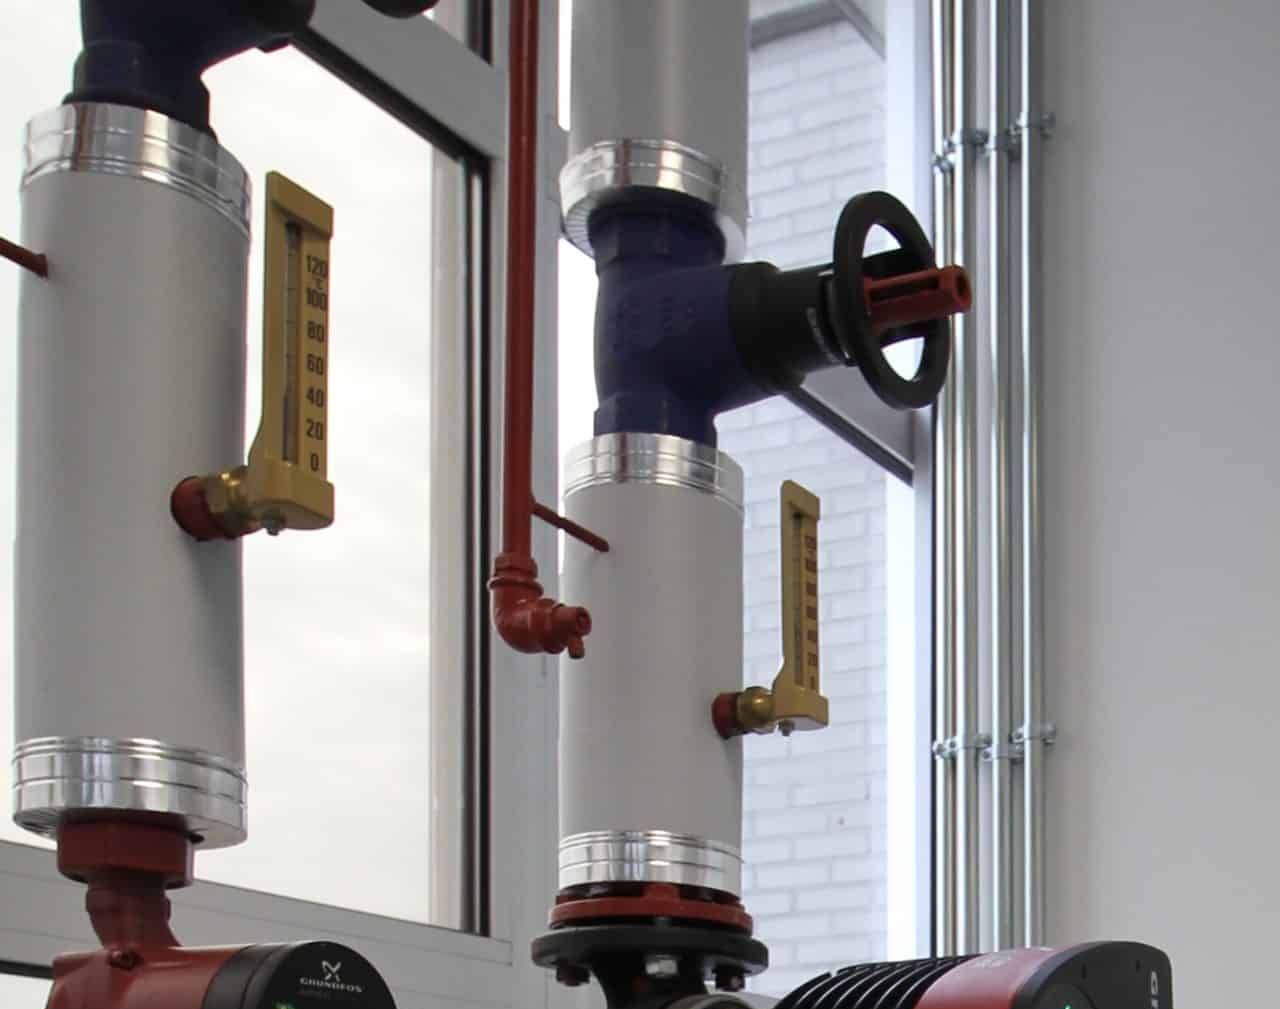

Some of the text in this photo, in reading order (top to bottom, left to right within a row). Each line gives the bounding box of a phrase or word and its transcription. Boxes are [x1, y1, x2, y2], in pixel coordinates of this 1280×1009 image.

[306, 255, 328, 278] 120
[306, 287, 328, 311] 100
[306, 320, 325, 343] 80
[306, 353, 324, 376] 60
[306, 386, 324, 408] 40
[306, 418, 324, 441] 20
[309, 452, 319, 472] 0
[300, 977, 363, 993] GRUNDFOS
